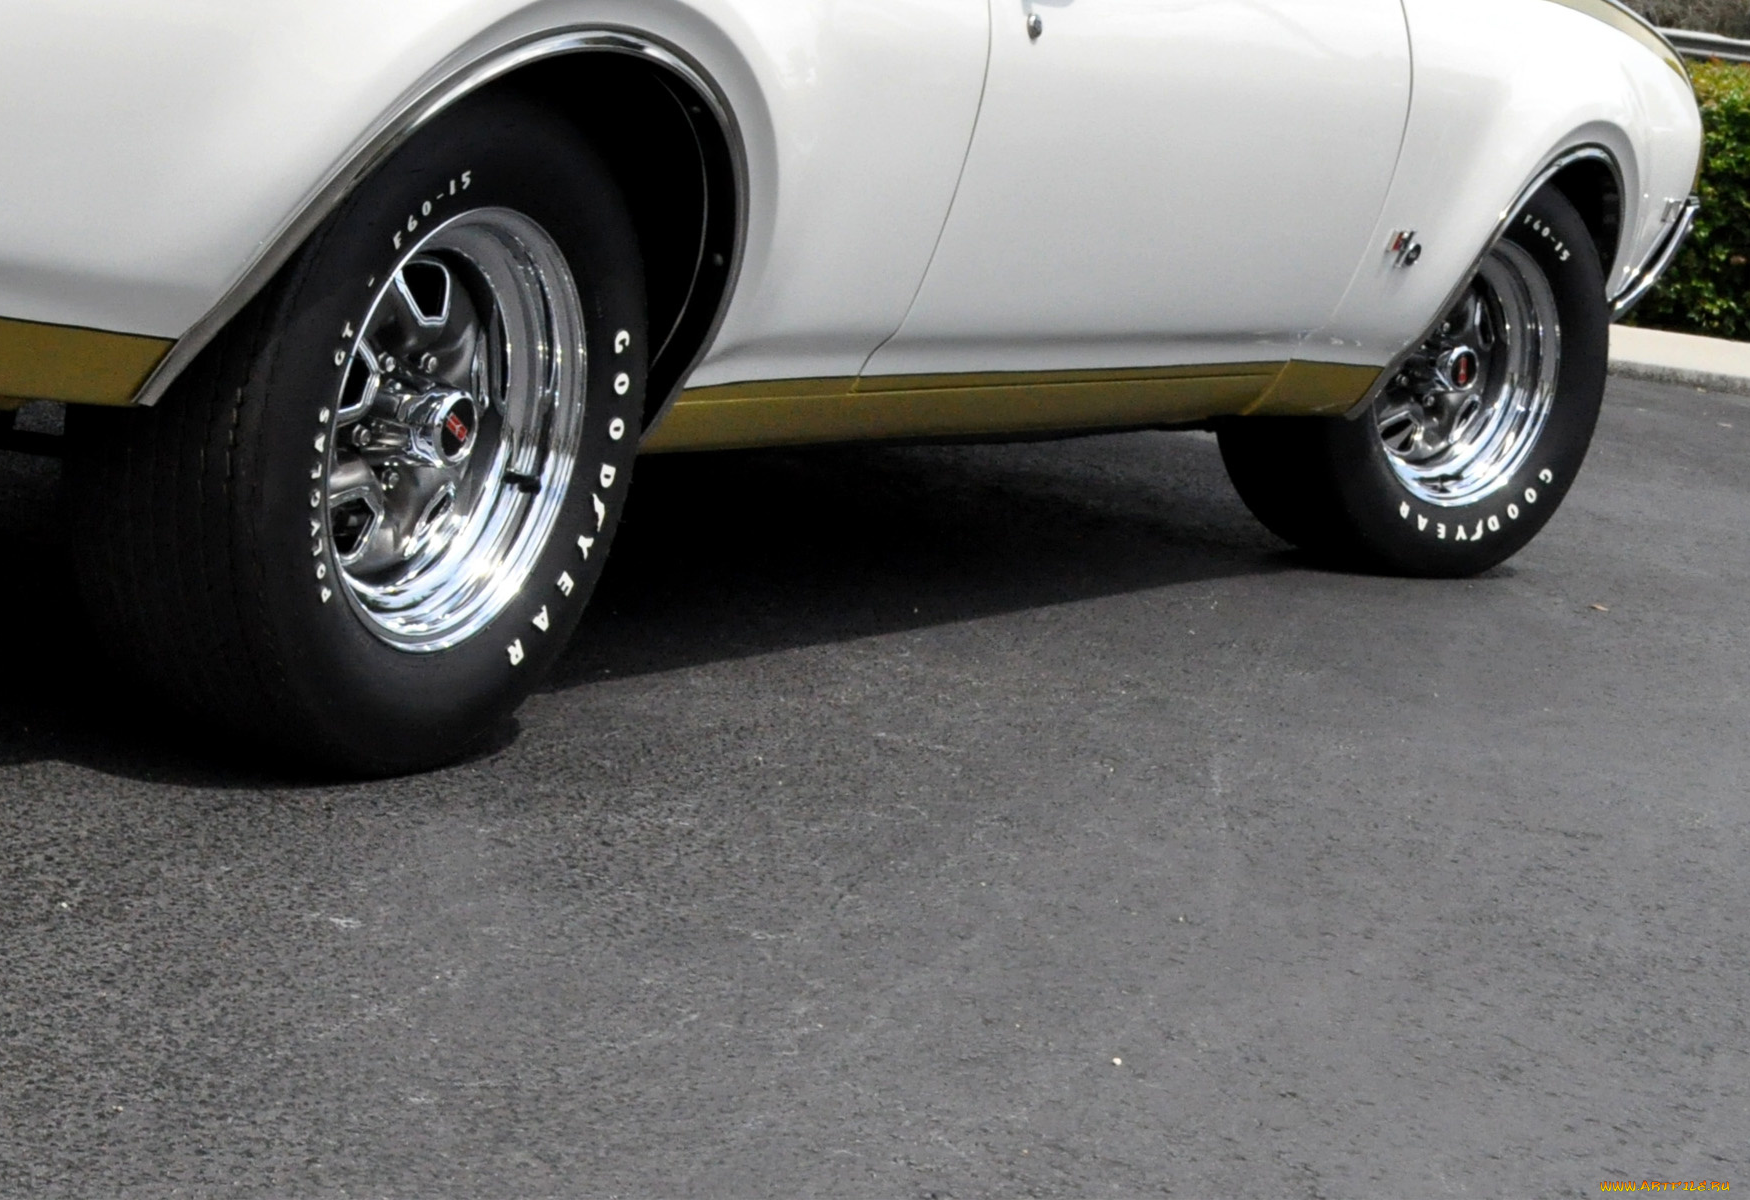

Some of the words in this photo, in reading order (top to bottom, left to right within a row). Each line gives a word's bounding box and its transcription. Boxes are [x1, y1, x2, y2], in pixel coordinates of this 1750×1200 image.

[1523, 214, 1570, 261] F60-15
[310, 405, 331, 604] POLYGLAS
[334, 321, 354, 366] GT
[393, 170, 471, 250] F60-15
[506, 329, 630, 666] GOODYEAR
[1399, 468, 1553, 542] GOODYEAR
